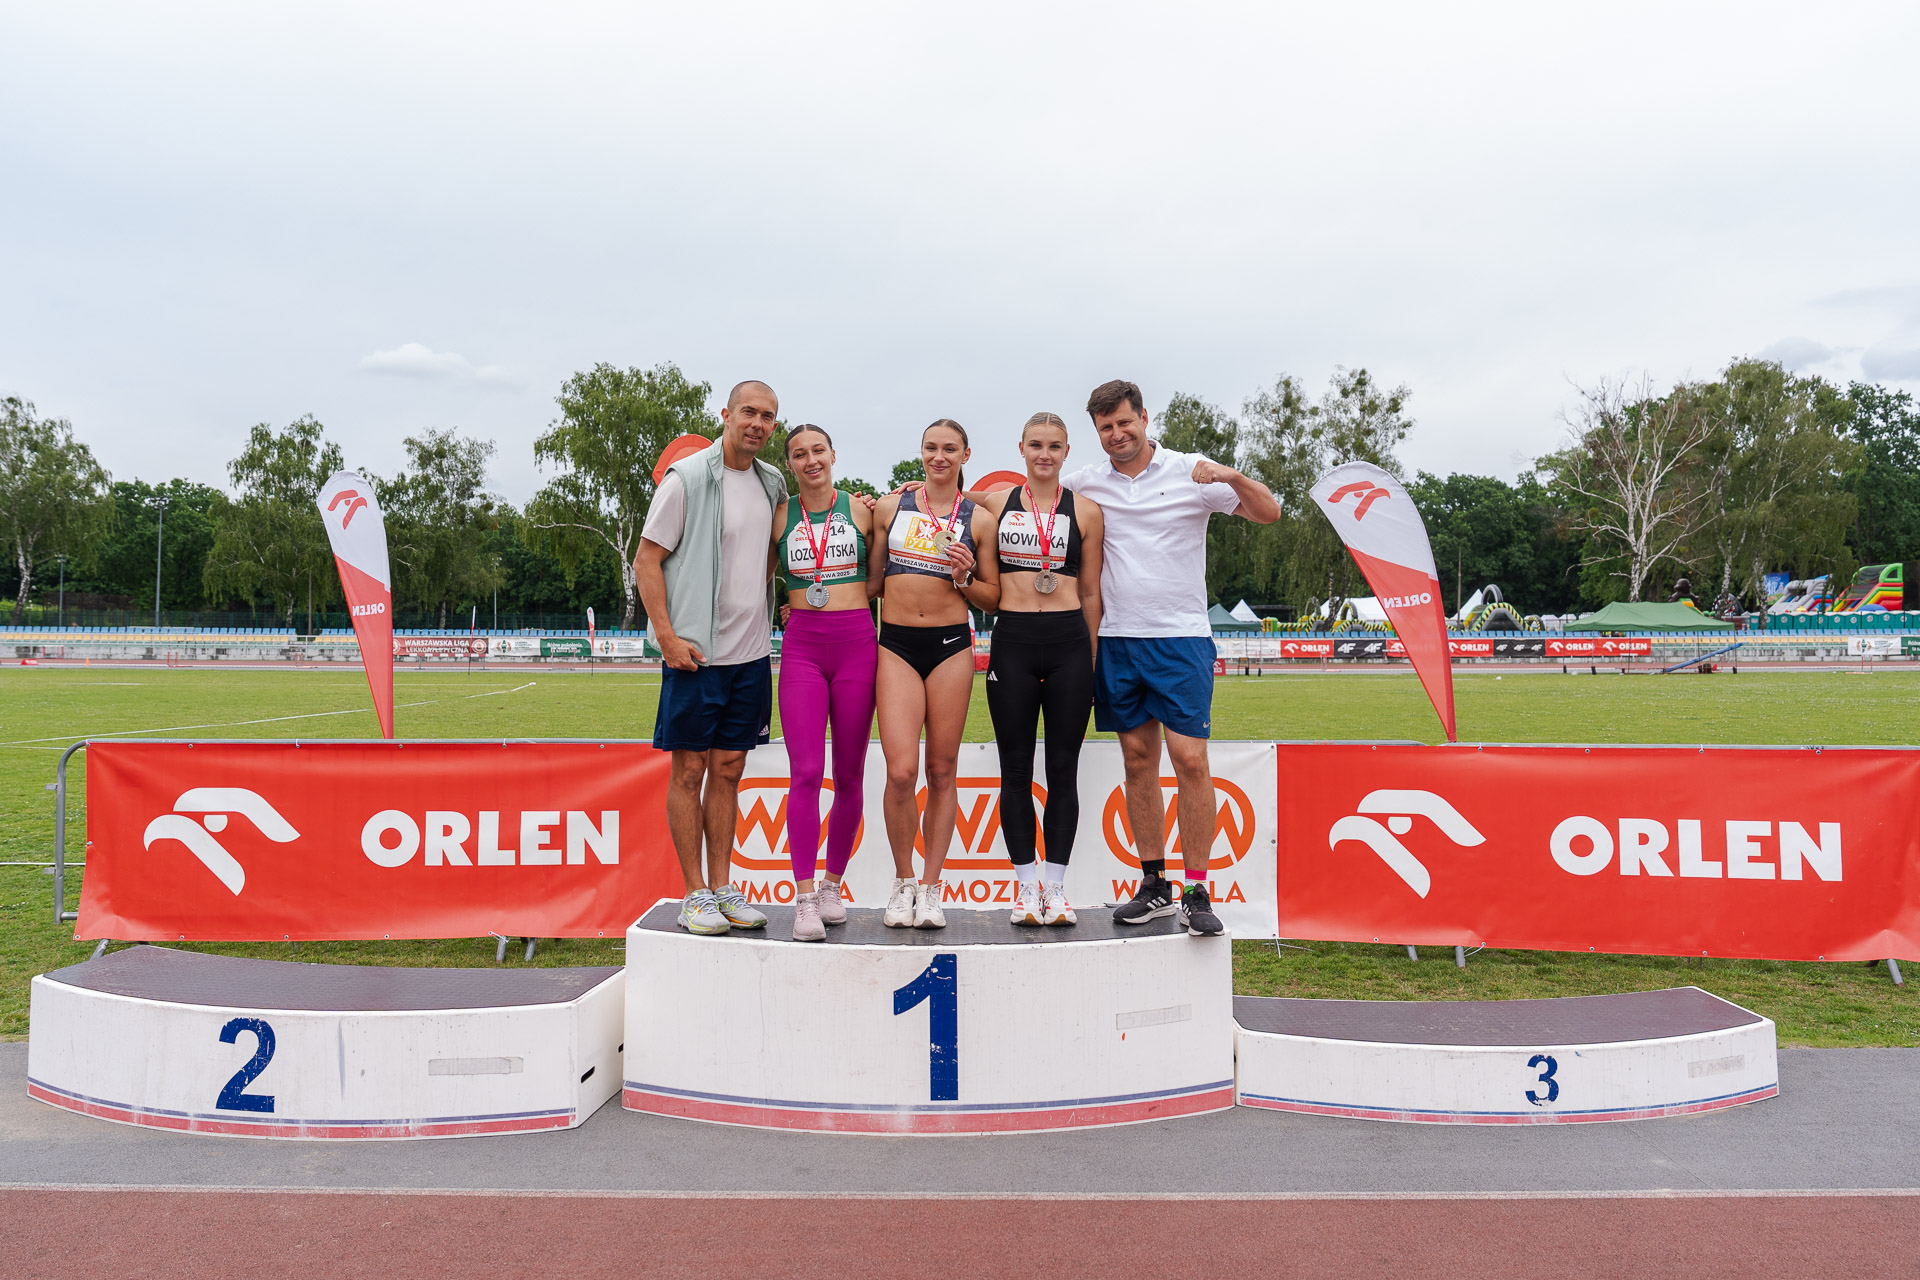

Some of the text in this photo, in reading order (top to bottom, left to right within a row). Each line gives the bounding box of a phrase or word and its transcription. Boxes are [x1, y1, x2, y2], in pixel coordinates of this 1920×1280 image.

[830, 525, 846, 536] 14
[907, 538, 937, 552] PZLA
[895, 557, 929, 569] WARSZAWA
[1301, 644, 1329, 652] ORLEN
[1338, 643, 1355, 653] 4F
[1364, 643, 1382, 653] 4F
[1460, 643, 1489, 651] ORLEN
[1566, 643, 1594, 651] ORLEN
[1619, 642, 1647, 650] ORLEN
[361, 809, 619, 867] ORLEN
[1550, 816, 1842, 882] ORLEN
[1112, 879, 1246, 903] WOLA
[893, 954, 958, 1100] 1
[215, 1017, 276, 1113] 2
[1525, 1054, 1559, 1106] 3
